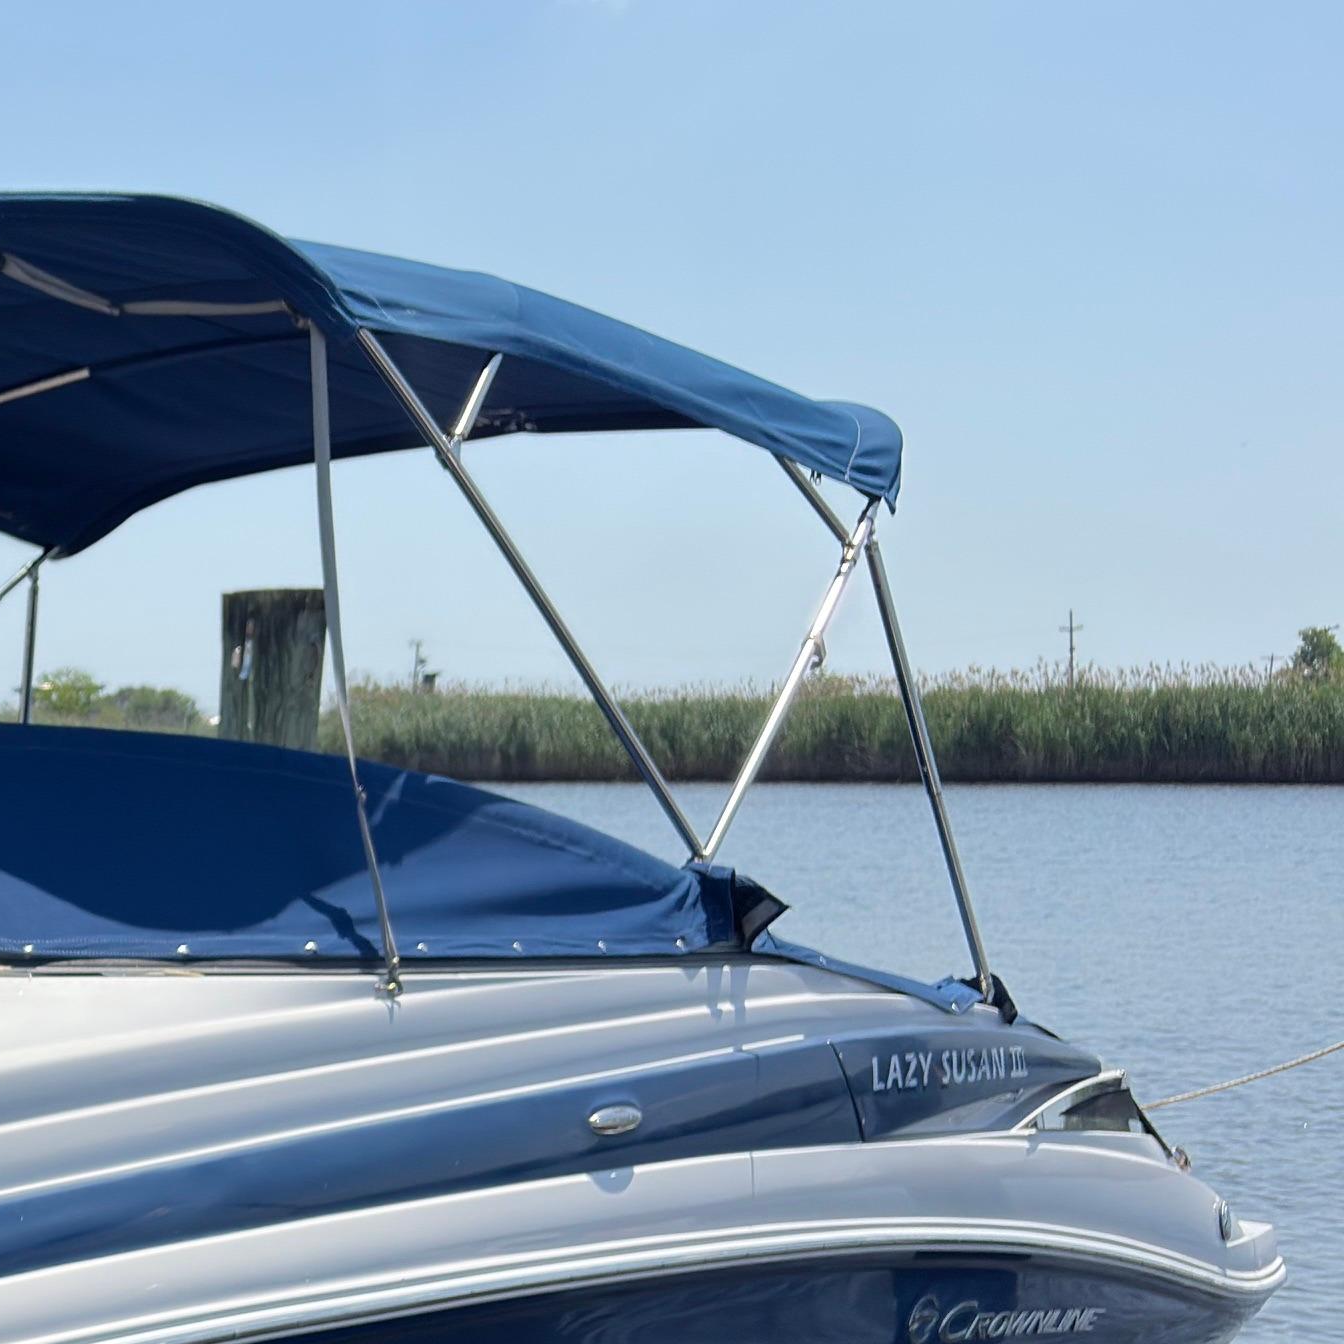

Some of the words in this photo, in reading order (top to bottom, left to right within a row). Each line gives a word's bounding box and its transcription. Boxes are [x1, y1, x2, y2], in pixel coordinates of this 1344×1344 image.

[871, 1051, 933, 1092] LAZY
[941, 1046, 1006, 1084] SUSAN
[1009, 1045, 1029, 1078] III
